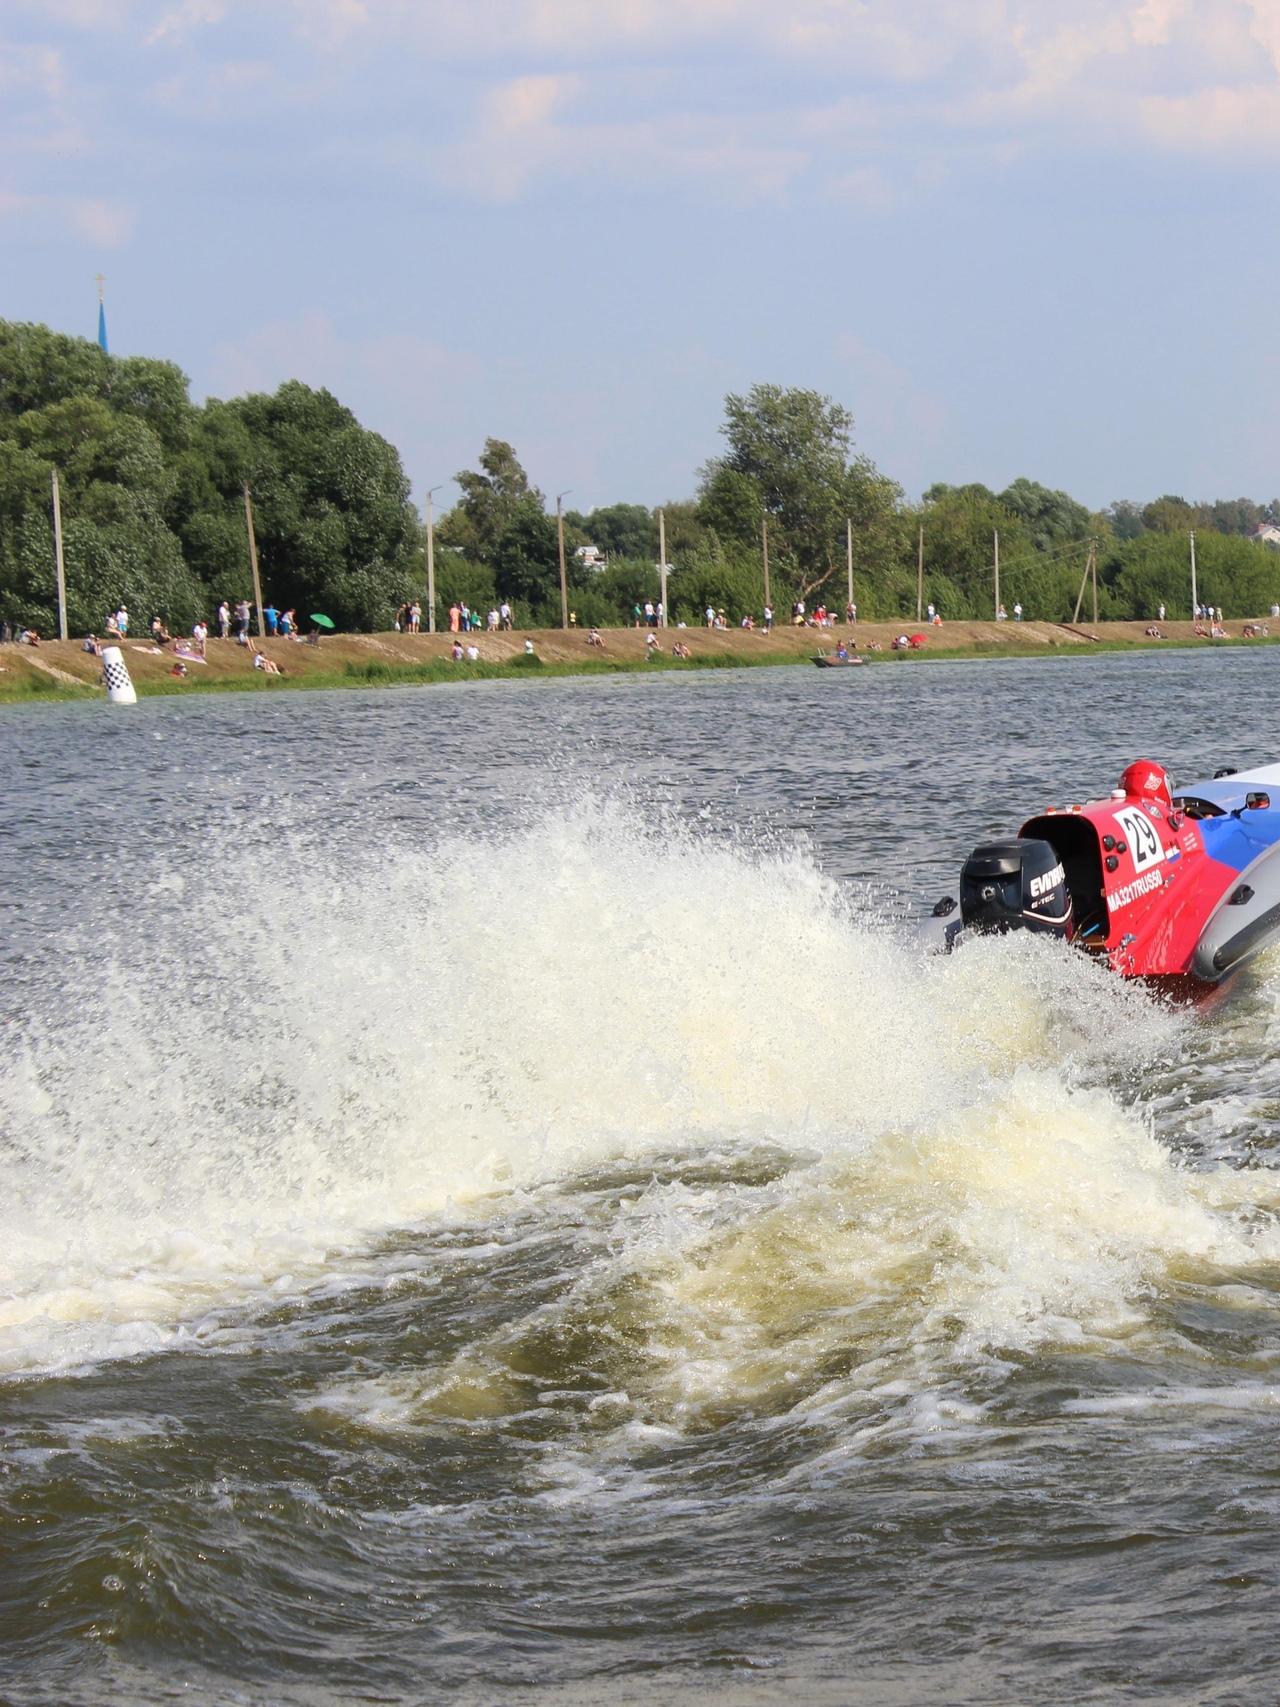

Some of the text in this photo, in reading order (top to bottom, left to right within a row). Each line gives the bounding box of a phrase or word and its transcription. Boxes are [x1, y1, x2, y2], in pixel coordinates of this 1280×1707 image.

[1123, 813, 1157, 863] 29
[1031, 893, 1055, 909] E-TEC
[1106, 869, 1163, 913] MA3217RUS50
